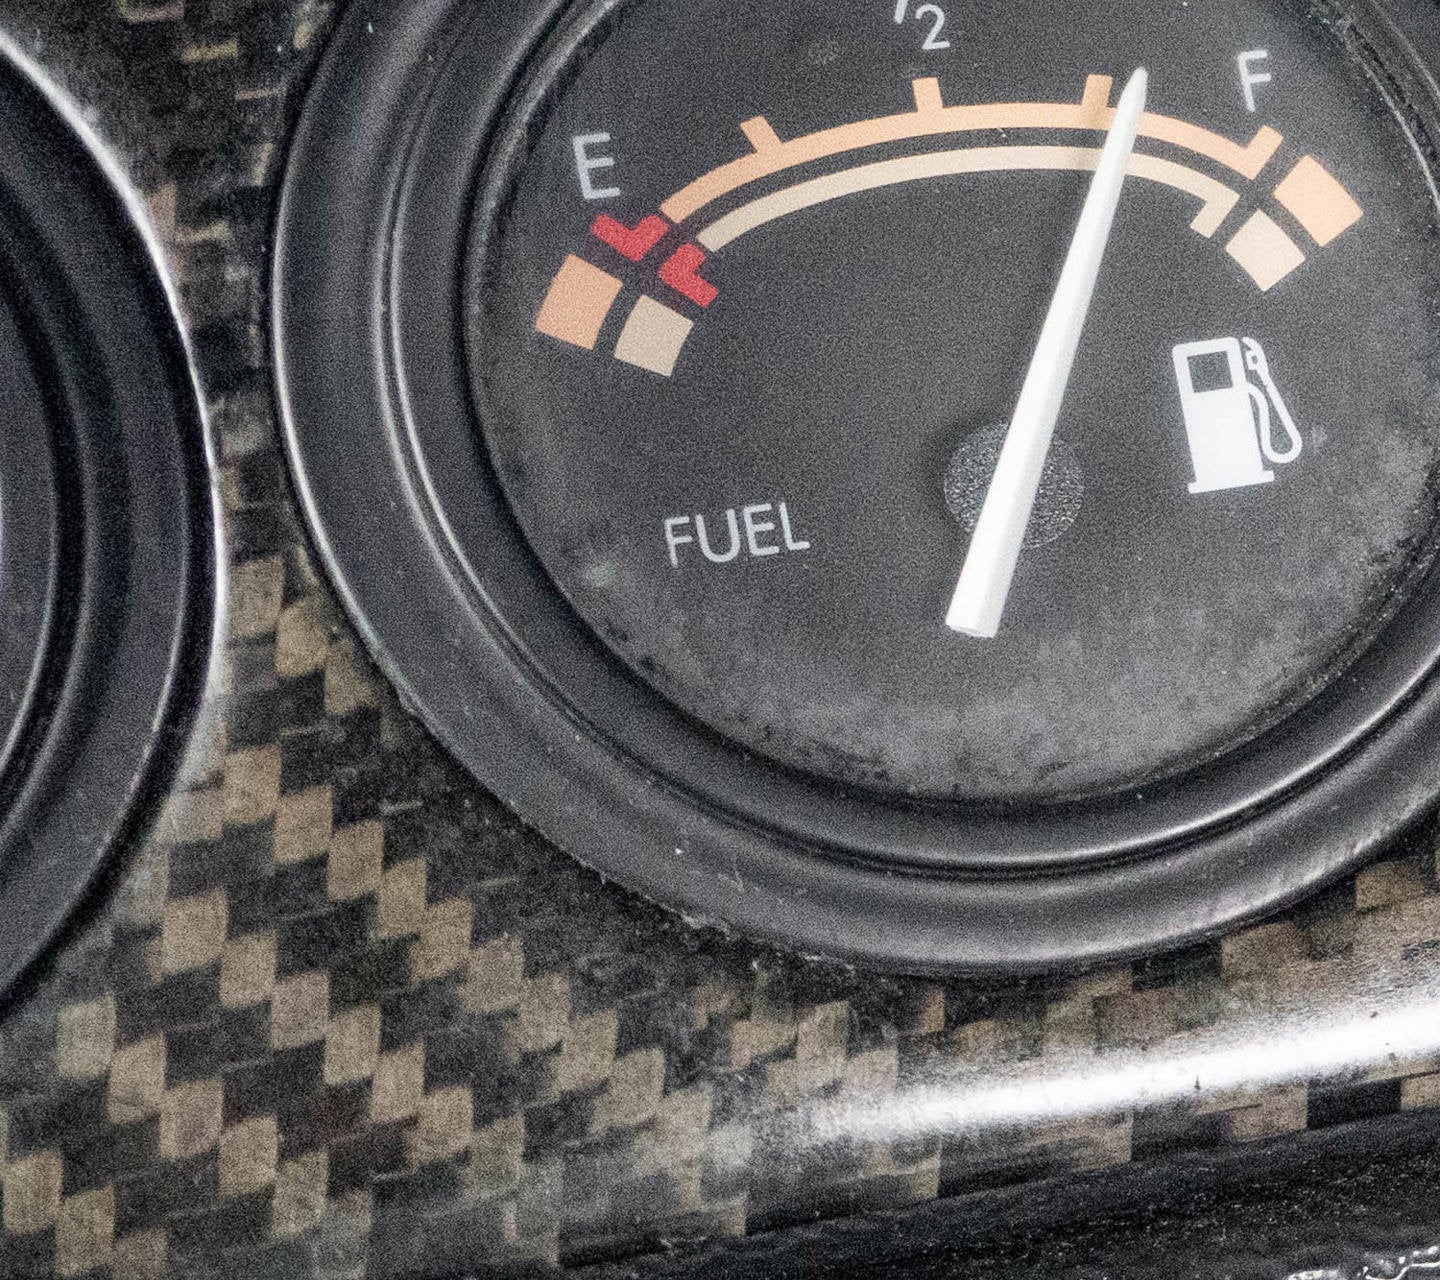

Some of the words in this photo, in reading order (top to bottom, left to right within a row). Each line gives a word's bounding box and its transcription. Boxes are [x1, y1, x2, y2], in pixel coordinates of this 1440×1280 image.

[1237, 50, 1273, 111] F
[572, 132, 620, 200] E
[663, 502, 811, 568] FUEL
